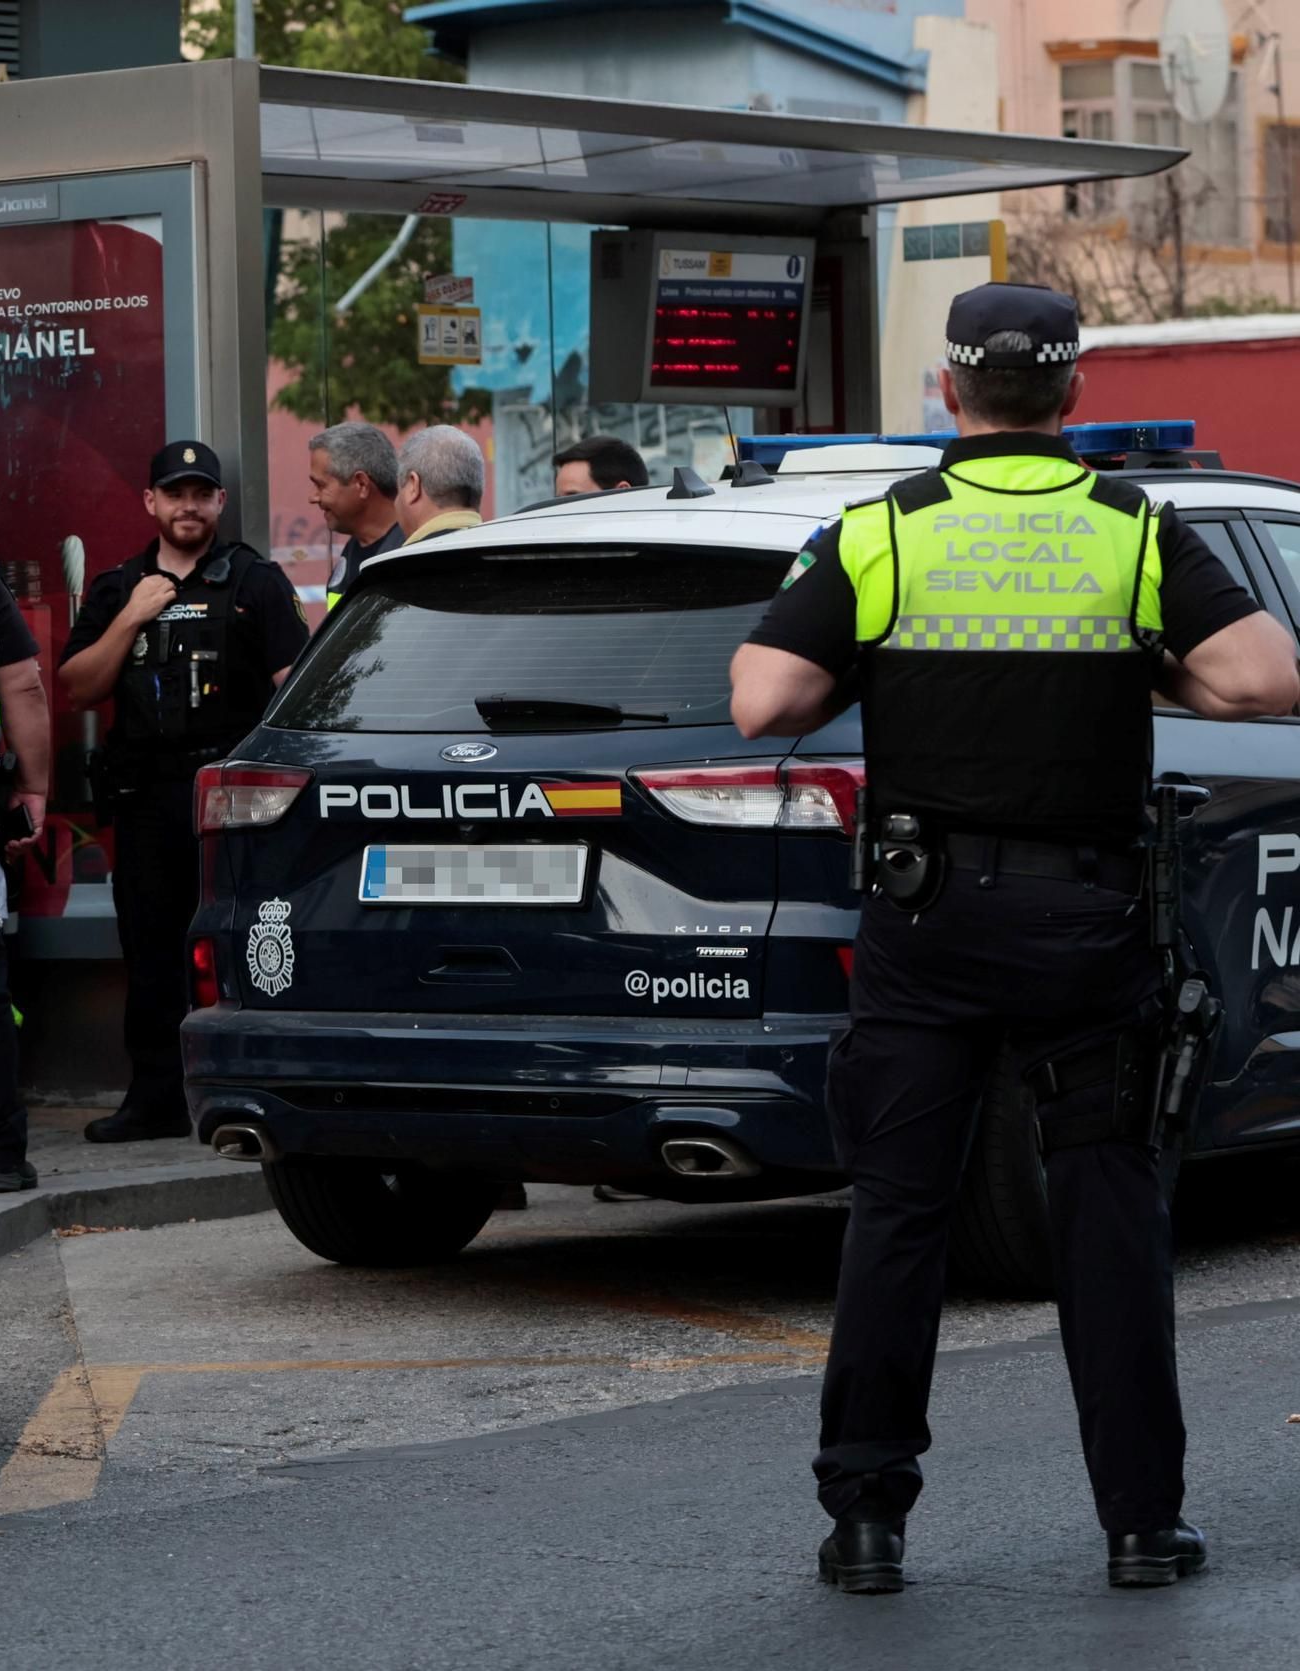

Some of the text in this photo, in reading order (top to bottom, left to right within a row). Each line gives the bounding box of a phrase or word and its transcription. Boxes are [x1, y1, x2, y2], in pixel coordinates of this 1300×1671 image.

[7, 305, 22, 317] EL
[24, 299, 92, 316] CONTORNO
[94, 297, 111, 311] DE
[113, 295, 149, 309] OJOS
[933, 511, 1097, 535] POLICÍA
[945, 541, 1085, 563] LOCAL
[925, 569, 1104, 594] SEVILLA
[450, 744, 483, 758] Ford
[675, 925, 752, 933] KUGA
[1251, 905, 1300, 970] N
[699, 948, 746, 956] HYBRID
[624, 969, 750, 1004] @policia
